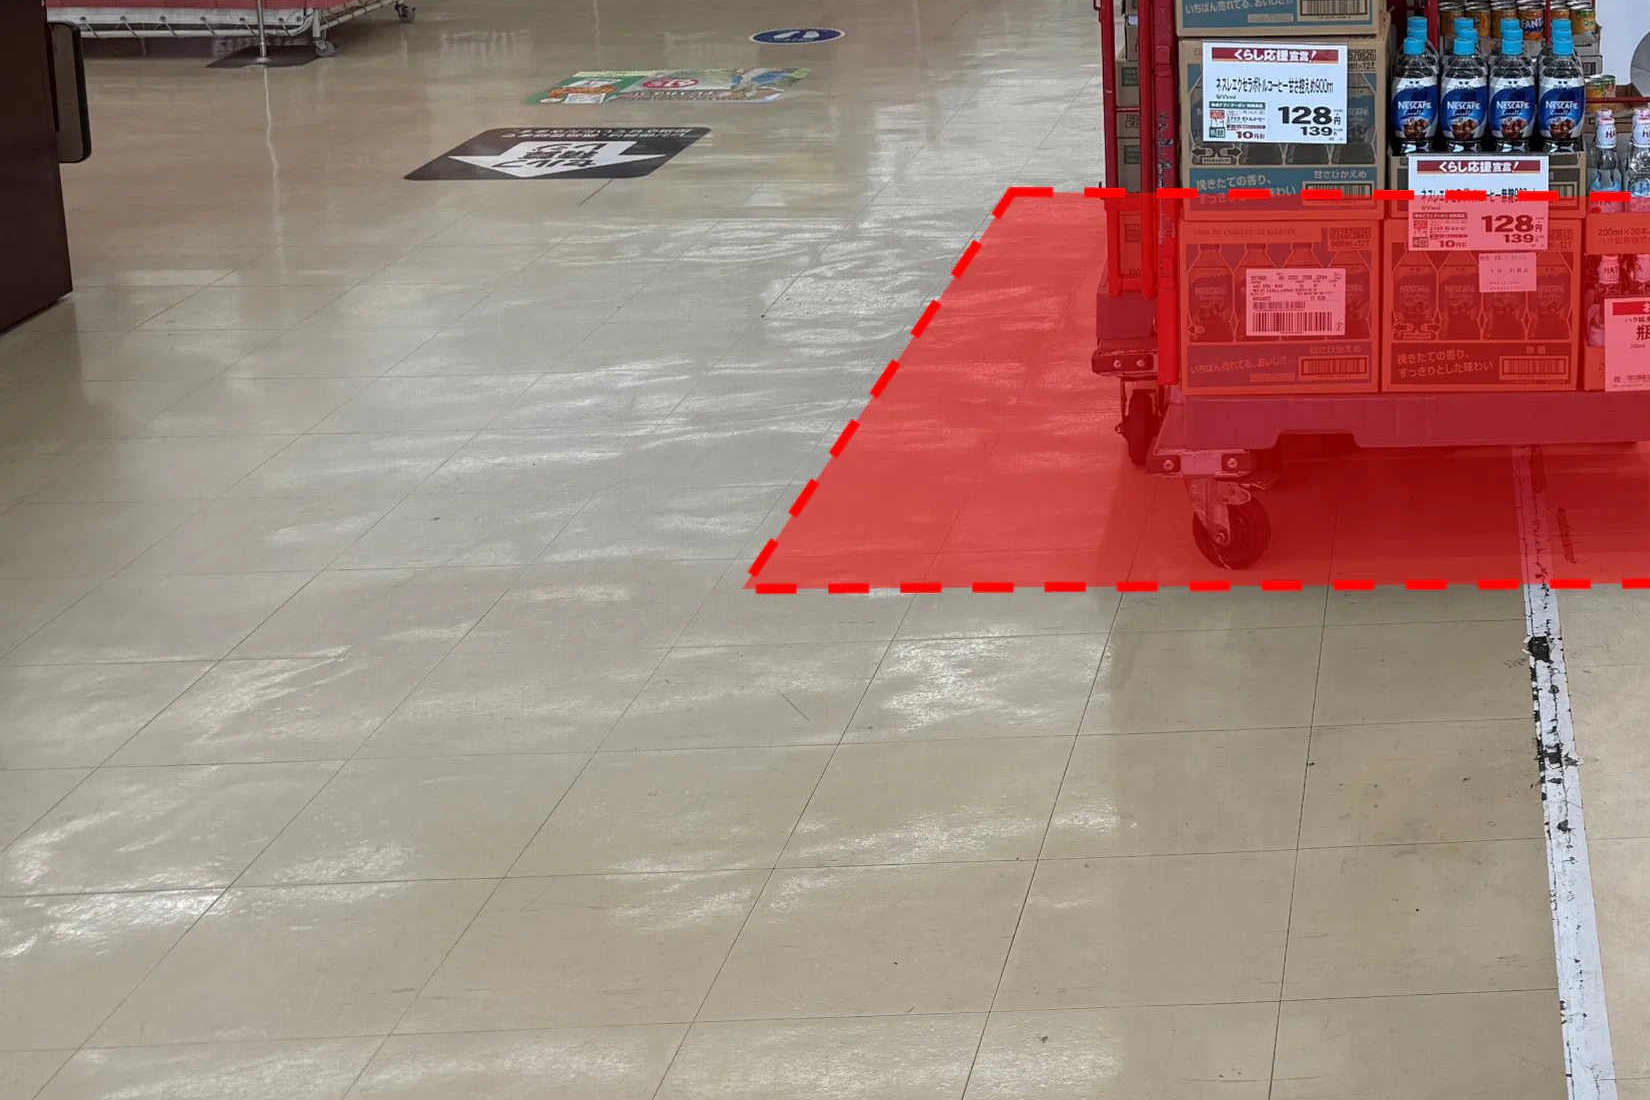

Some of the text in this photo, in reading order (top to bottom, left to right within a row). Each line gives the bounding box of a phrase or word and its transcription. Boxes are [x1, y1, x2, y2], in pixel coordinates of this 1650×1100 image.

[1234, 50, 1317, 62] くらし応援宣言!
[1278, 107, 1332, 125] 128
[1300, 127, 1332, 136] 139
[1439, 162, 1519, 173] くらし応援宣言!
[1481, 215, 1533, 232] 128
[1503, 234, 1534, 243] 139
[1398, 360, 1493, 378] すっきりとした味わい
